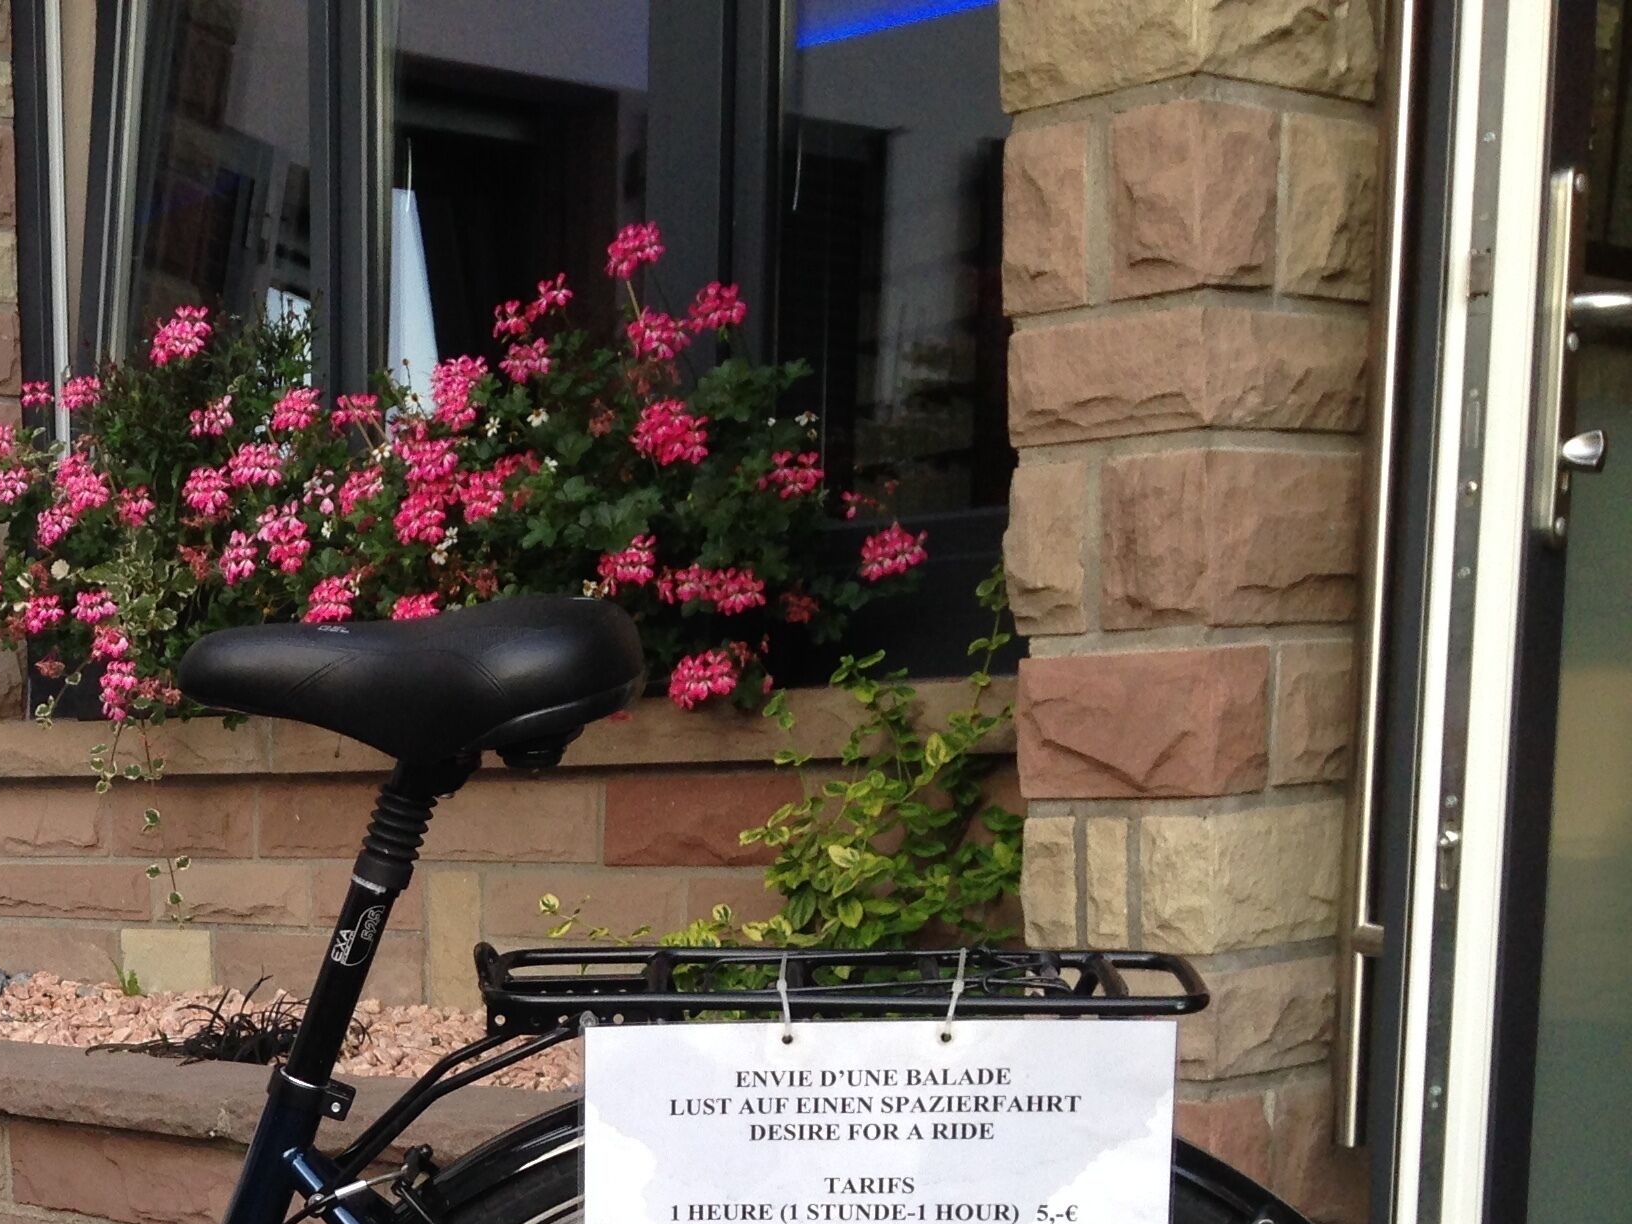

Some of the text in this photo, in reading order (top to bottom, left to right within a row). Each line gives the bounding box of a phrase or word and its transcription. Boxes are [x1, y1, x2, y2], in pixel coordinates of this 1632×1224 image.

[331, 929, 354, 963] EXA
[735, 1069, 813, 1088] ENVIE
[906, 1067, 1012, 1087] BALADE
[669, 1094, 1082, 1117] LUST AUF EINEN SPAZIERFAHRT
[748, 1122, 995, 1142] DESIRE FOR A RIDE
[823, 1176, 915, 1195] TARIFS
[671, 1204, 680, 1222] 1
[687, 1203, 773, 1222] HEURE
[779, 1203, 798, 1224] (1
[806, 1203, 926, 1221] STUNDE-1
